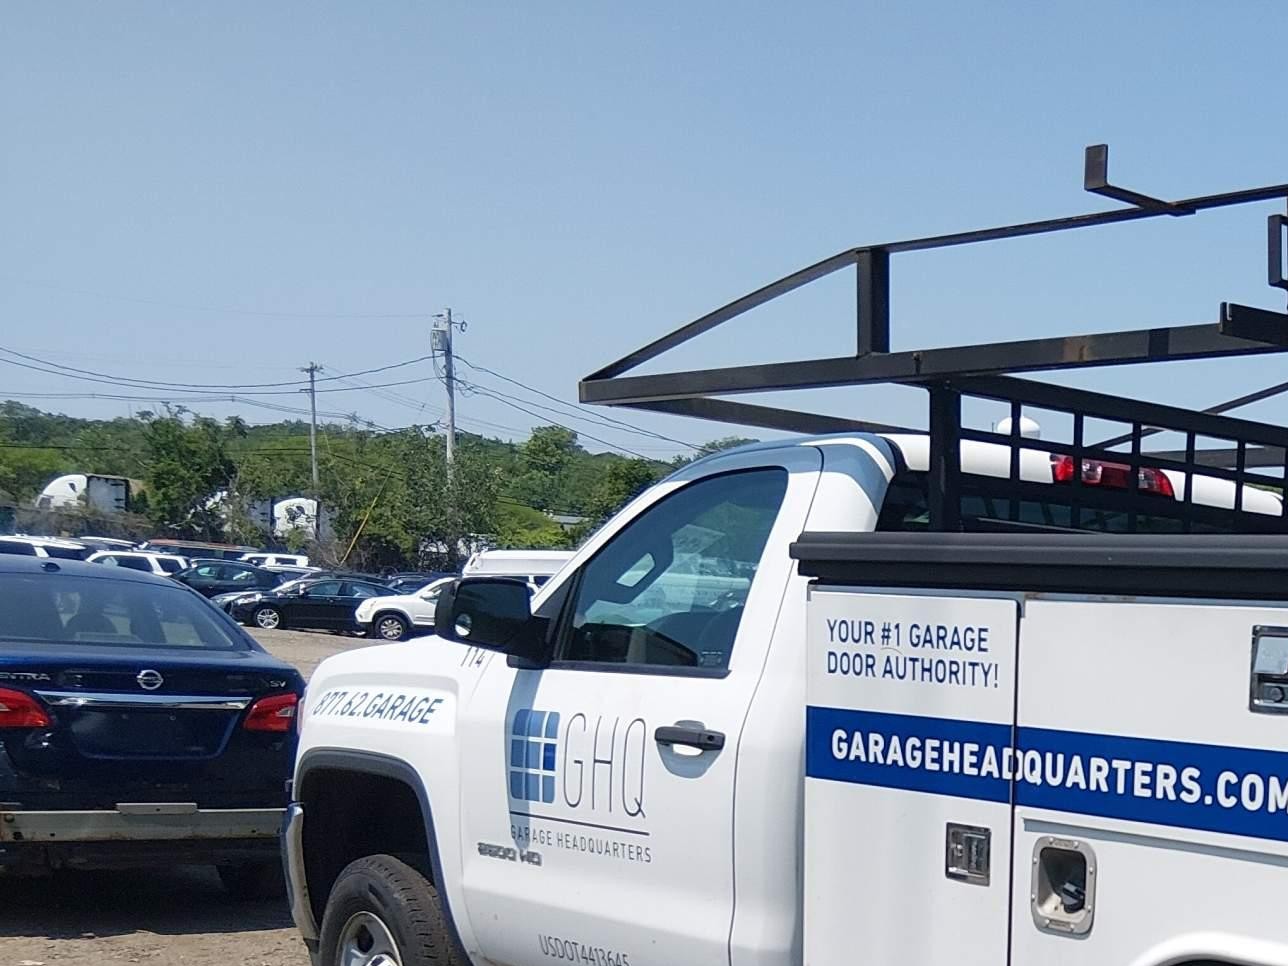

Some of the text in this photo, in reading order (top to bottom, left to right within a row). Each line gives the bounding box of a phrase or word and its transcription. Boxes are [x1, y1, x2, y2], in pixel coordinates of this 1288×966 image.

[827, 619, 989, 652] YOUR #1 GARAGE
[461, 646, 487, 668] 114
[827, 651, 998, 688] DOOR AUTHORITY!
[269, 680, 286, 688] SV
[313, 691, 444, 724] 877.62.GARAGE
[564, 713, 646, 818] GHQ
[511, 824, 651, 863] GARAGE HEADQUARTERS
